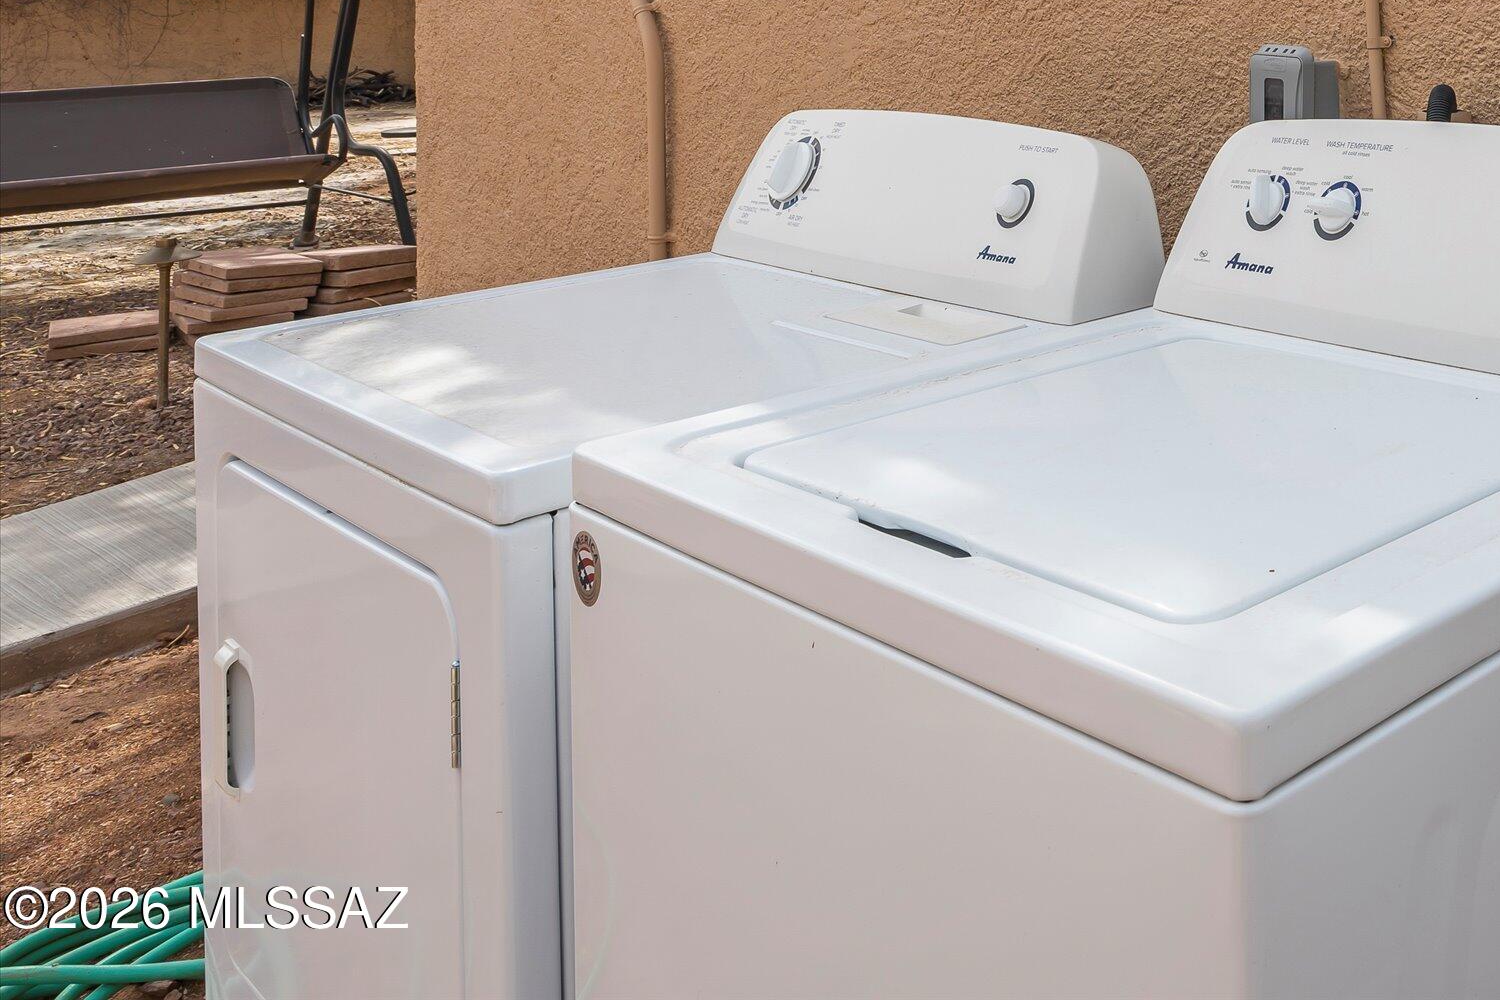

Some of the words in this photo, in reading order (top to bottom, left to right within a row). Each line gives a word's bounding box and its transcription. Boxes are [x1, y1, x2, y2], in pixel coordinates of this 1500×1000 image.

[1272, 137, 1291, 145] WATER
[1292, 138, 1310, 146] LEVEL
[1326, 141, 1346, 149] WASH
[1346, 142, 1394, 152] TEMPERATURE
[976, 246, 1016, 264] Amana
[1225, 252, 1274, 274] Amana
